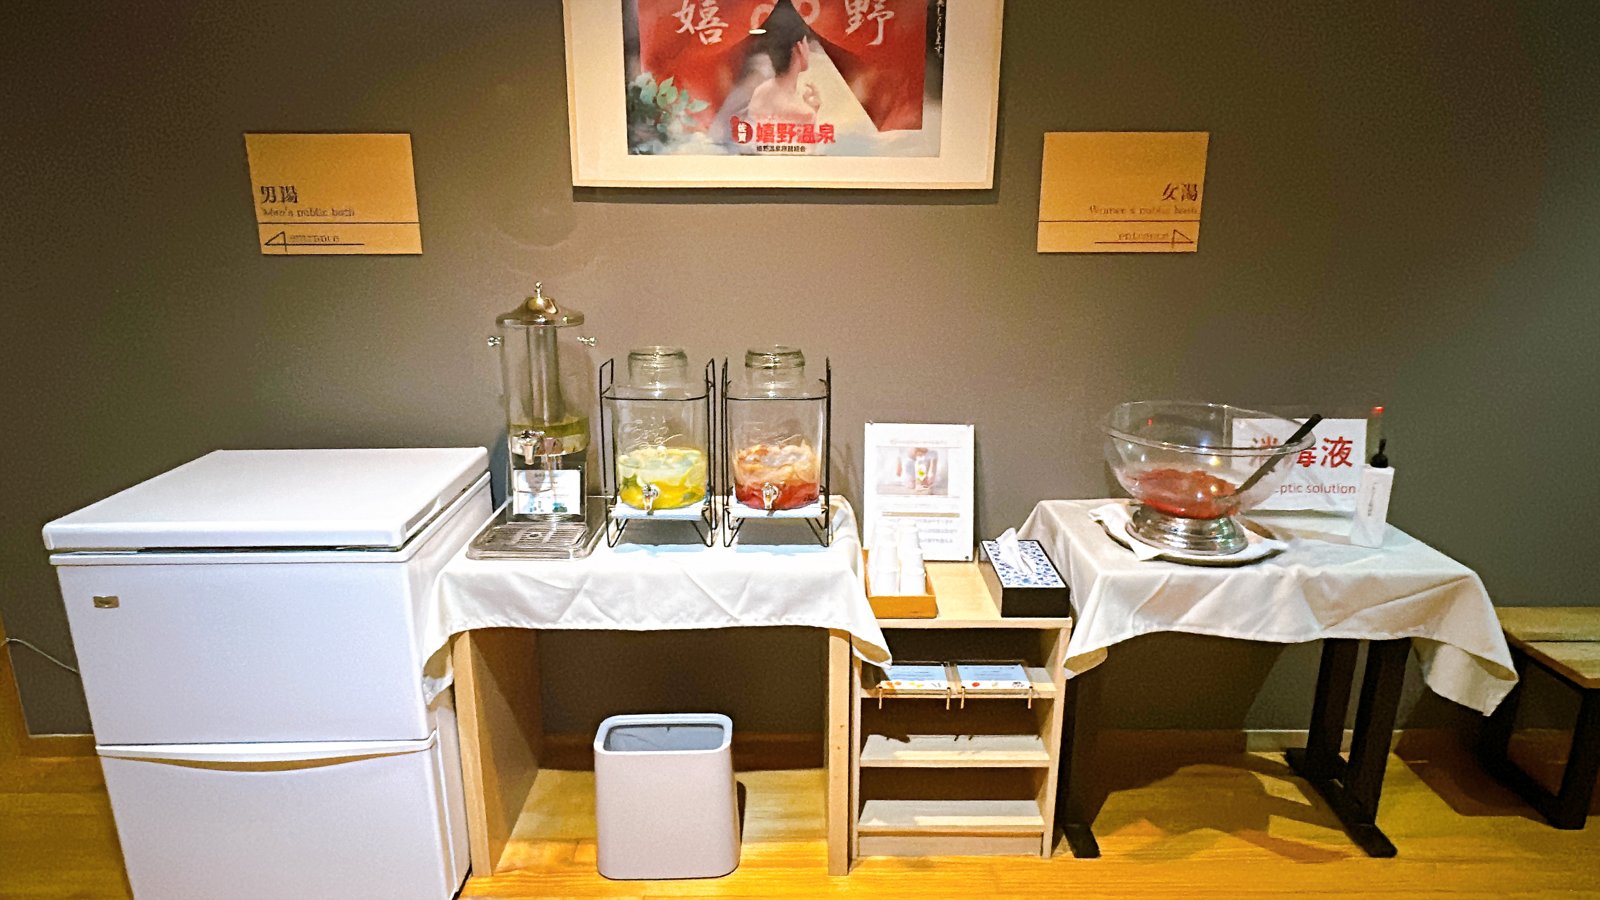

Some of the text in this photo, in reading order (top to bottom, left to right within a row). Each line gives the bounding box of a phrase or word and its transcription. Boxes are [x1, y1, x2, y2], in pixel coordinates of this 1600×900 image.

[756, 122, 836, 144] 嬉野温泉
[260, 185, 298, 204] 男湯
[1161, 182, 1199, 202] 女湯
[1306, 482, 1357, 494] solution
